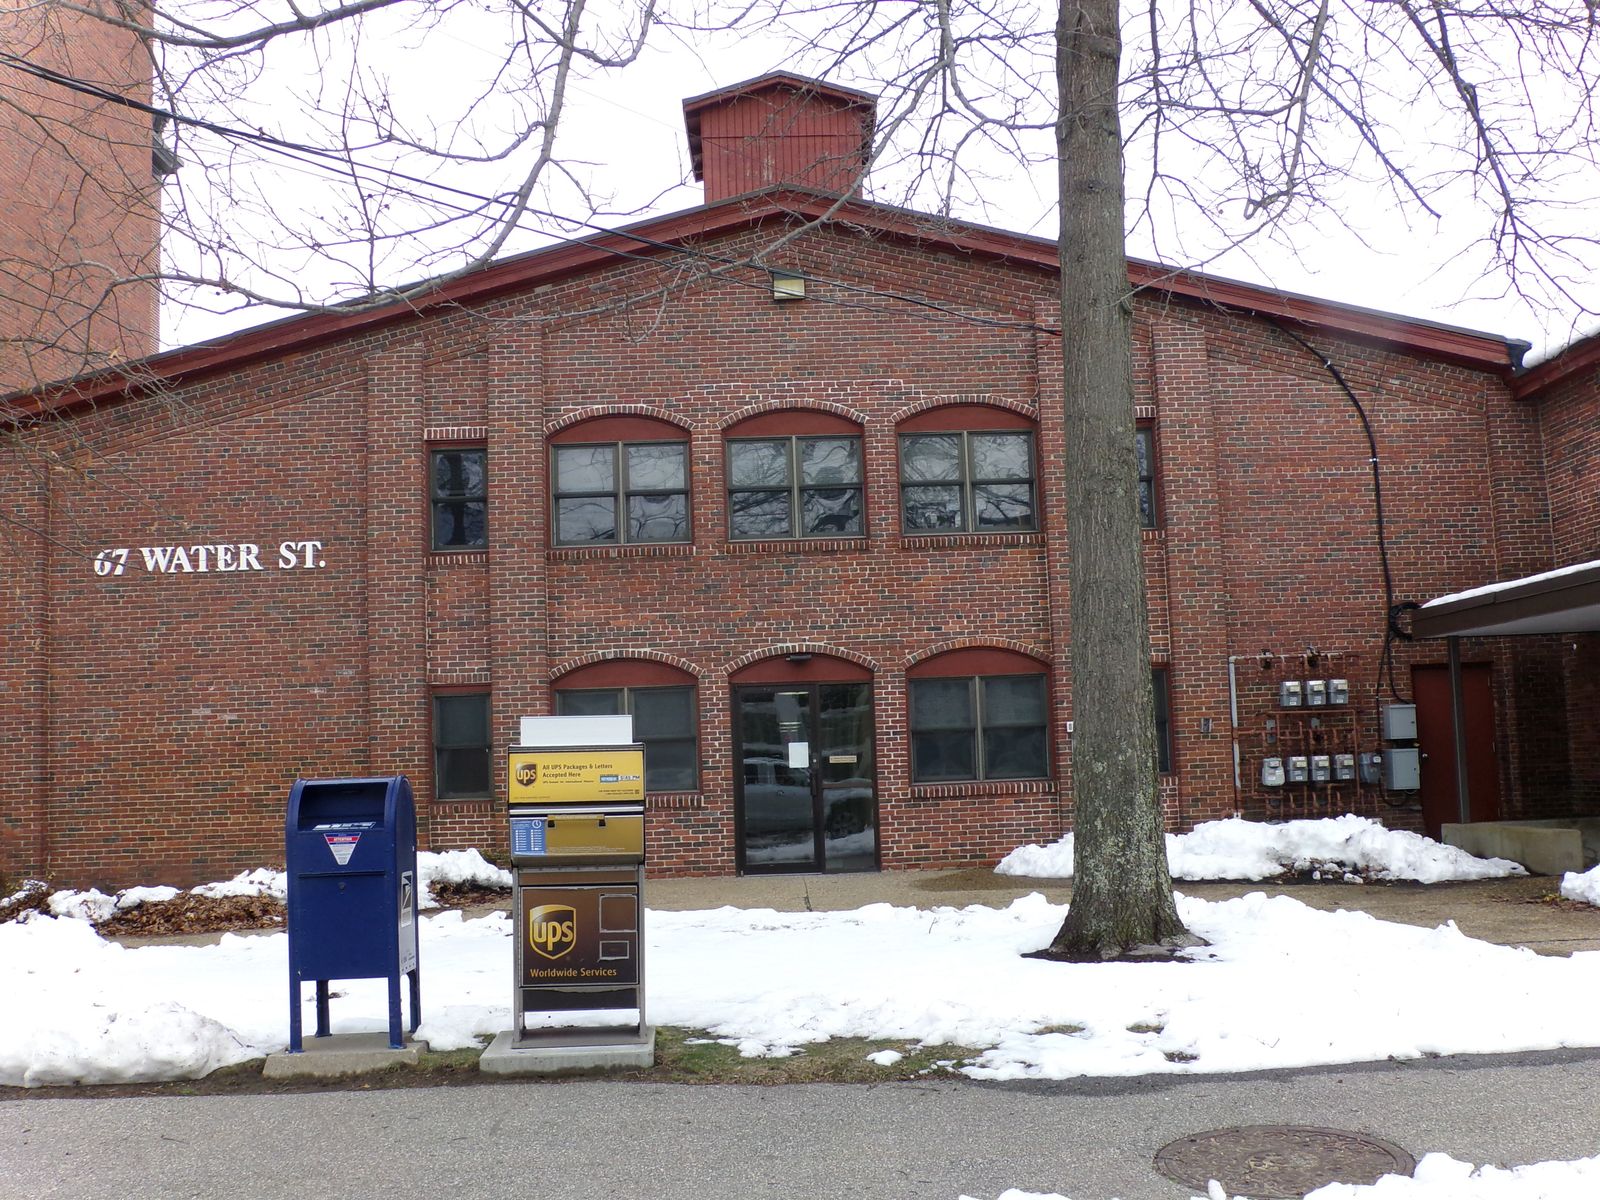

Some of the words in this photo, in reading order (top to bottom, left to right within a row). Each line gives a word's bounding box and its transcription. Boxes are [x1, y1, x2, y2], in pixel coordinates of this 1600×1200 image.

[94, 549, 129, 576] 67
[139, 543, 264, 573] WATER
[278, 541, 326, 569] ST.
[563, 763, 588, 771] Packages
[542, 771, 567, 779] Accepted
[533, 921, 573, 951] ups
[530, 968, 578, 977] Worldwide
[580, 967, 617, 976] Services
